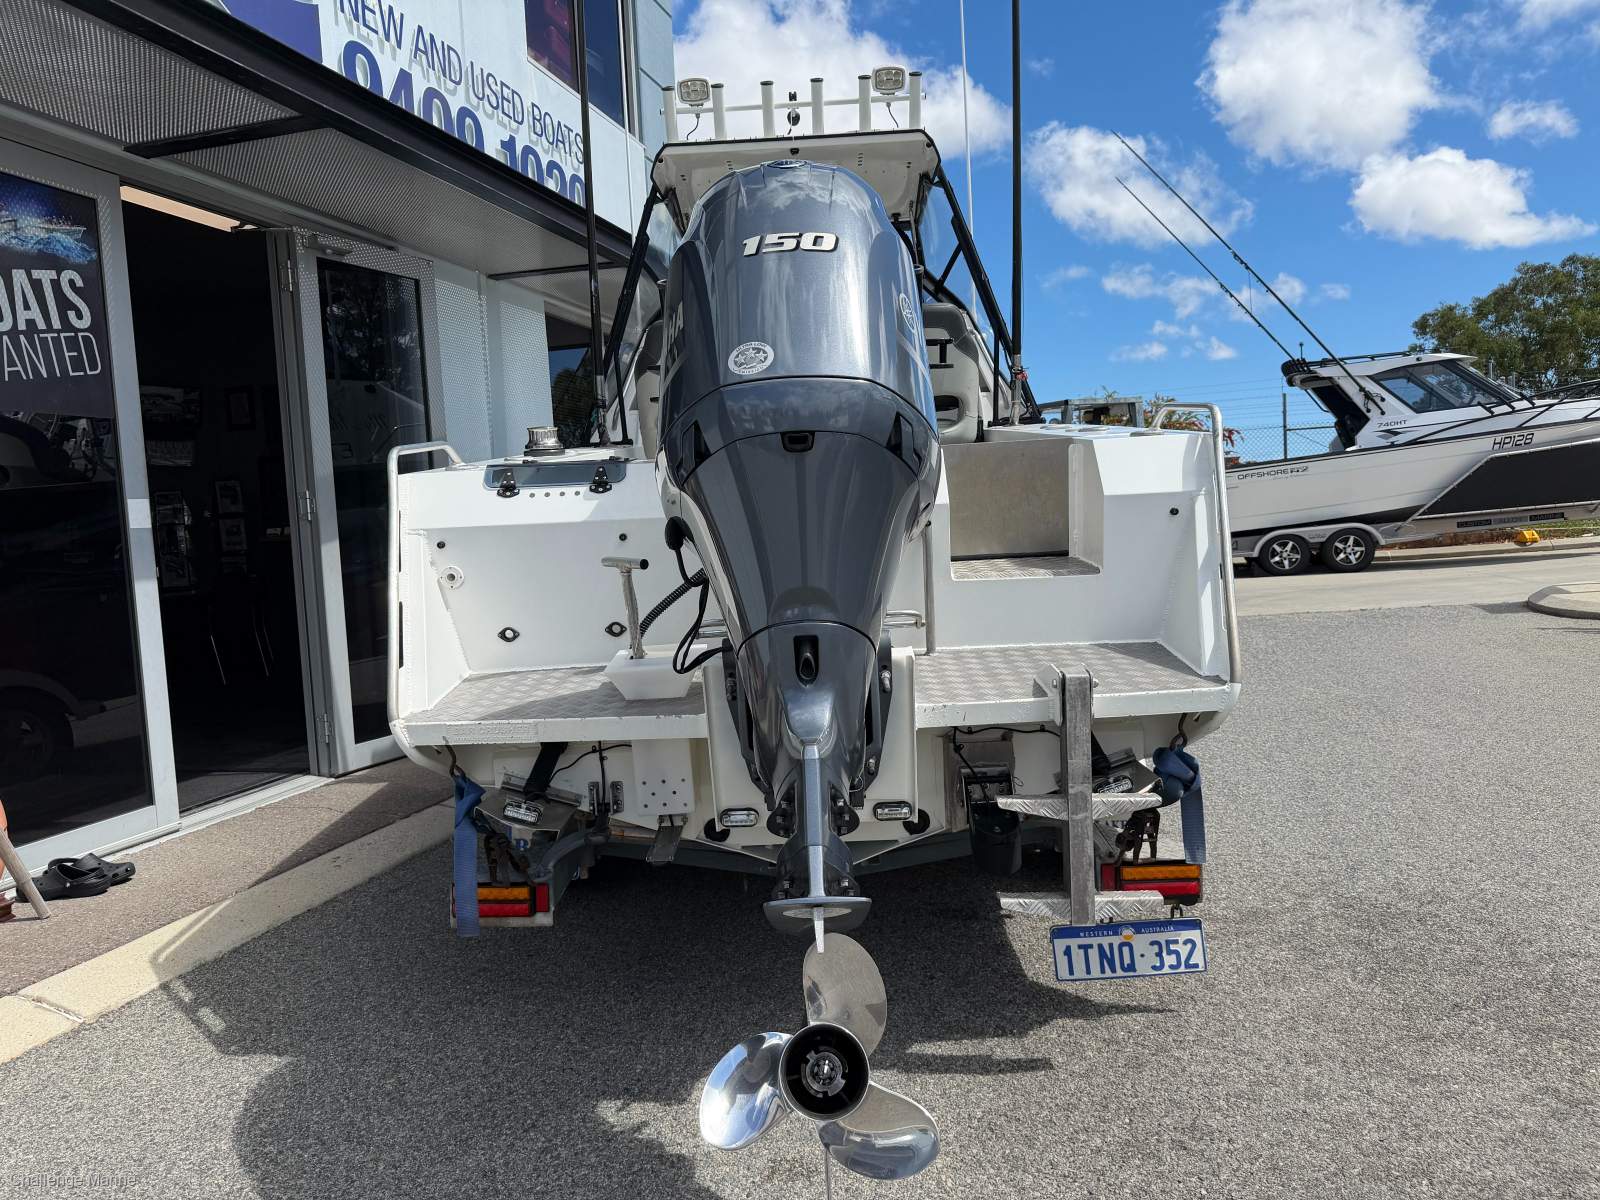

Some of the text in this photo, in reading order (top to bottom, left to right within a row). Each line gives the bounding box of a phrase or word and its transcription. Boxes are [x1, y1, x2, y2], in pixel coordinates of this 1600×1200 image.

[413, 24, 463, 86] AND
[469, 60, 525, 126] USED
[531, 101, 584, 165] BOATS
[743, 232, 838, 257] 150
[1492, 432, 1535, 450] HP128
[1237, 468, 1289, 480] OFFSHORE
[1141, 926, 1174, 934] AUSTRALIA
